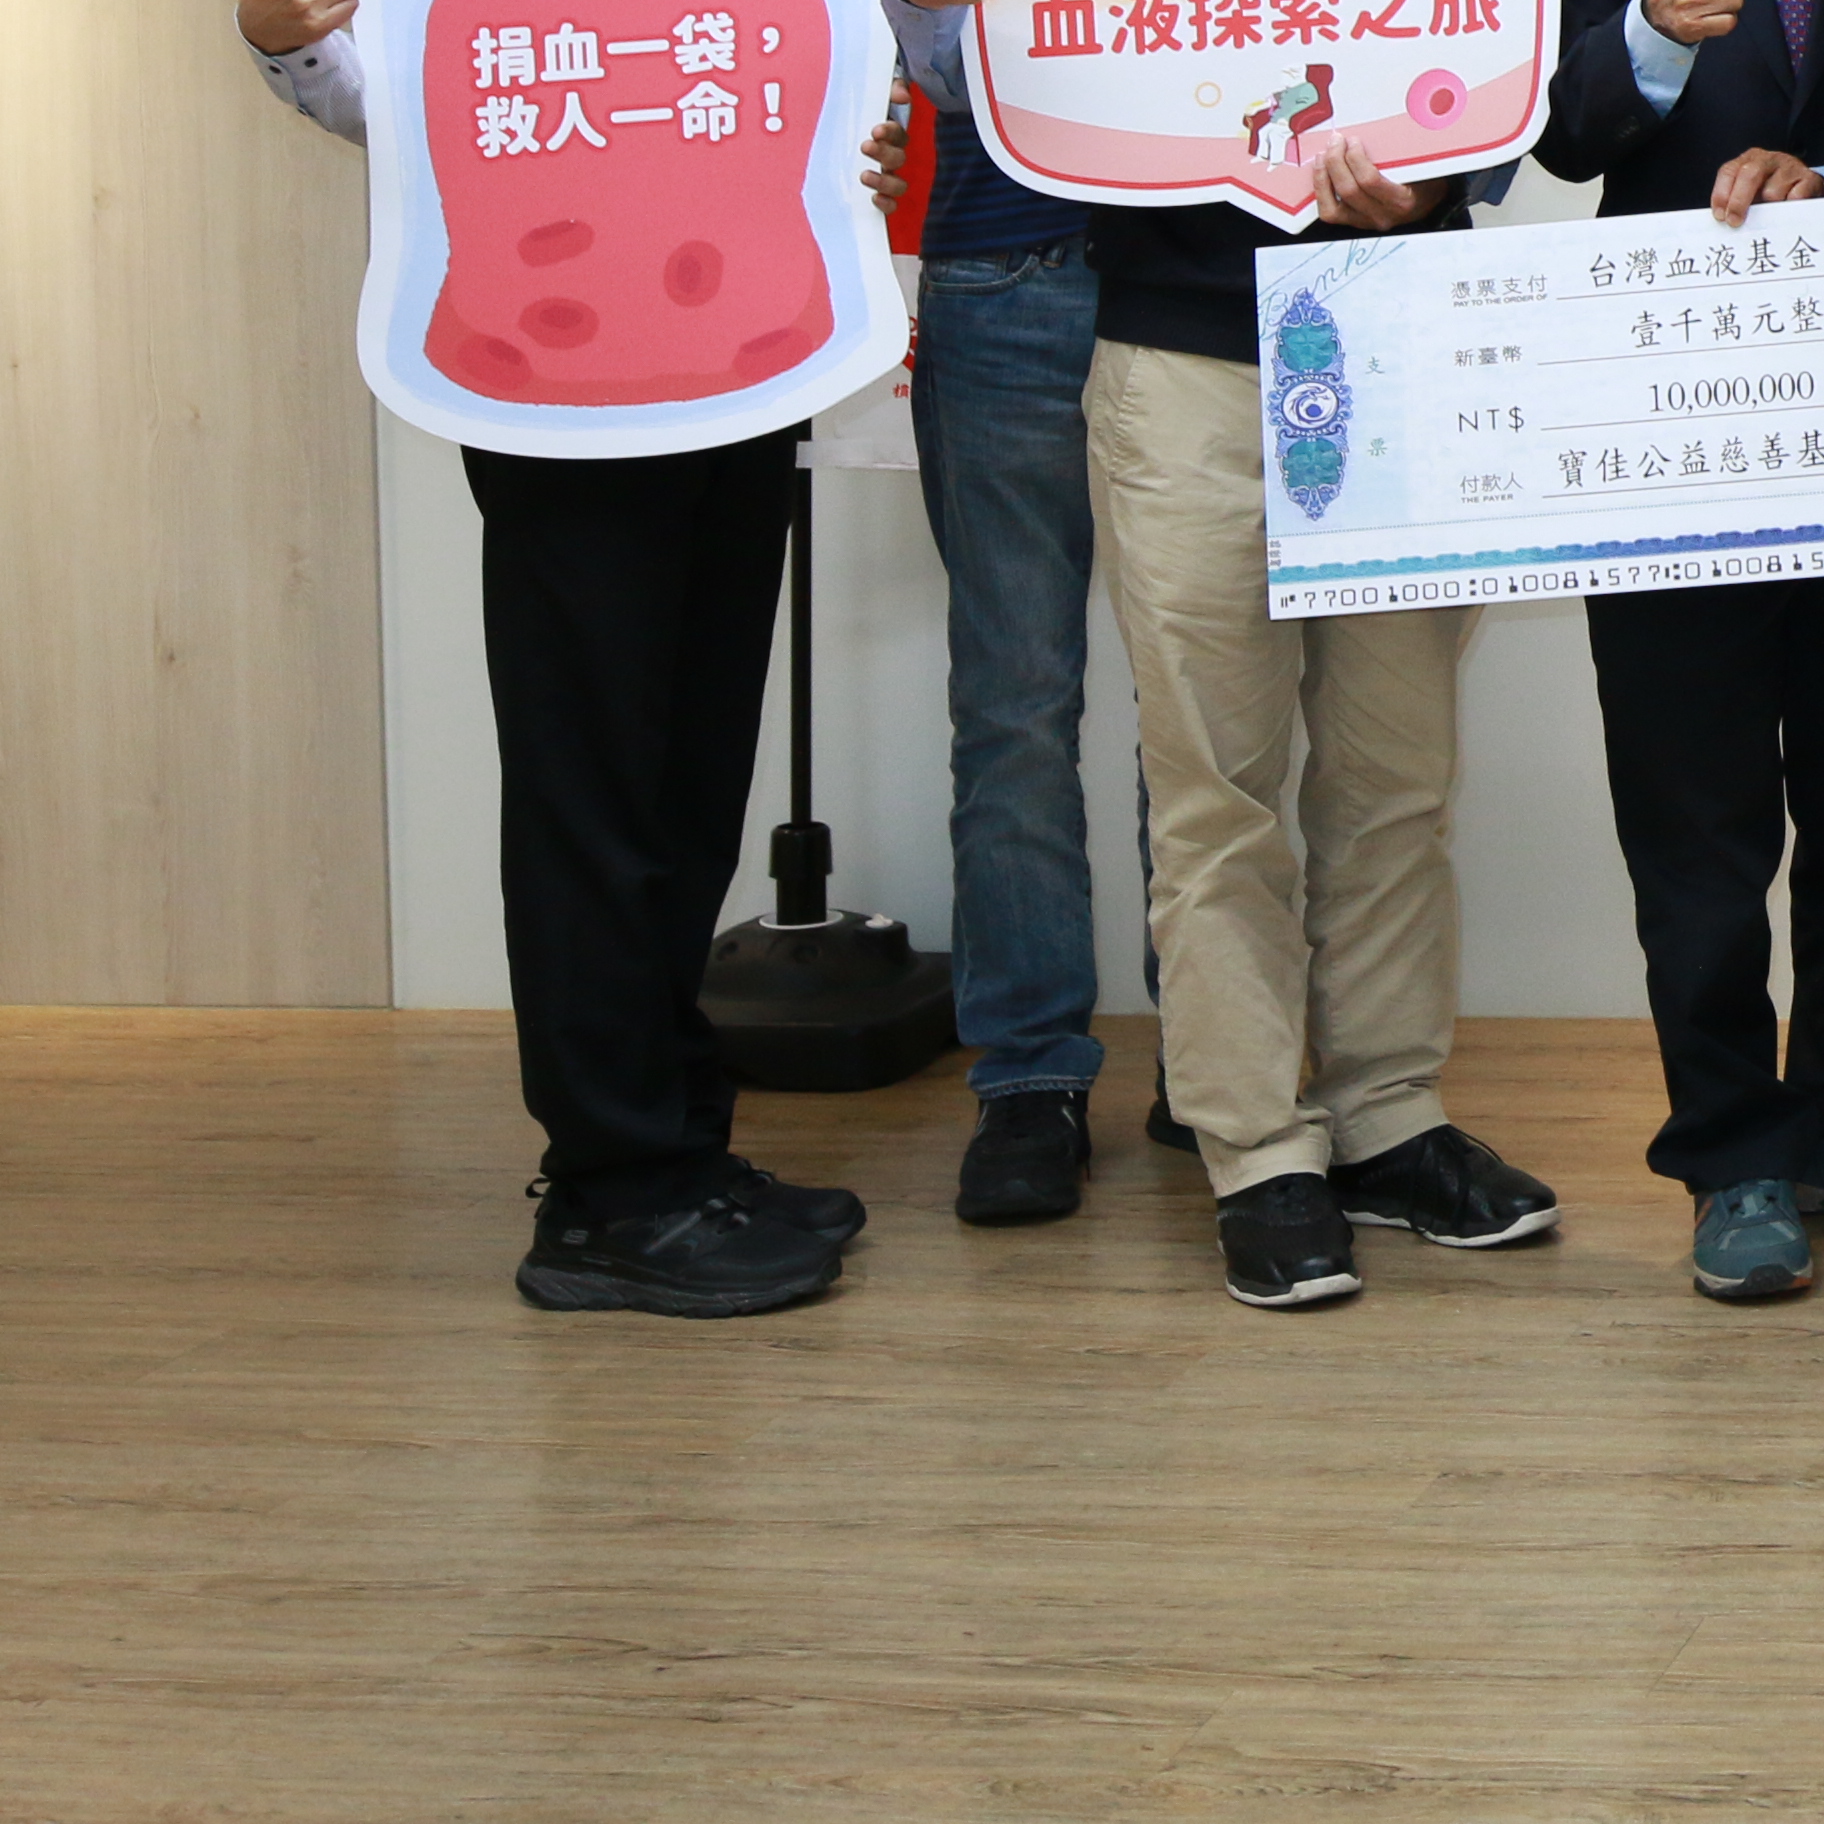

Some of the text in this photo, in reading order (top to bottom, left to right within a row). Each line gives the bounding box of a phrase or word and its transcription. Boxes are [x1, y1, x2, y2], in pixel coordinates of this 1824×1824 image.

[472, 12, 782, 89] 捐血一袋，
[475, 82, 784, 158] 救人一命！
[1259, 238, 1381, 342] Bnk
[1451, 274, 1547, 299] 憑票支付
[1485, 297, 1501, 305] THE
[1503, 295, 1534, 304] ORDER
[1631, 295, 1824, 348] 壹千萬元整
[1454, 345, 1522, 367] 新臺幣
[1648, 370, 1815, 416] 10,000,000
[1459, 472, 1524, 494] 付款人
[1461, 493, 1514, 504] THE PAYER
